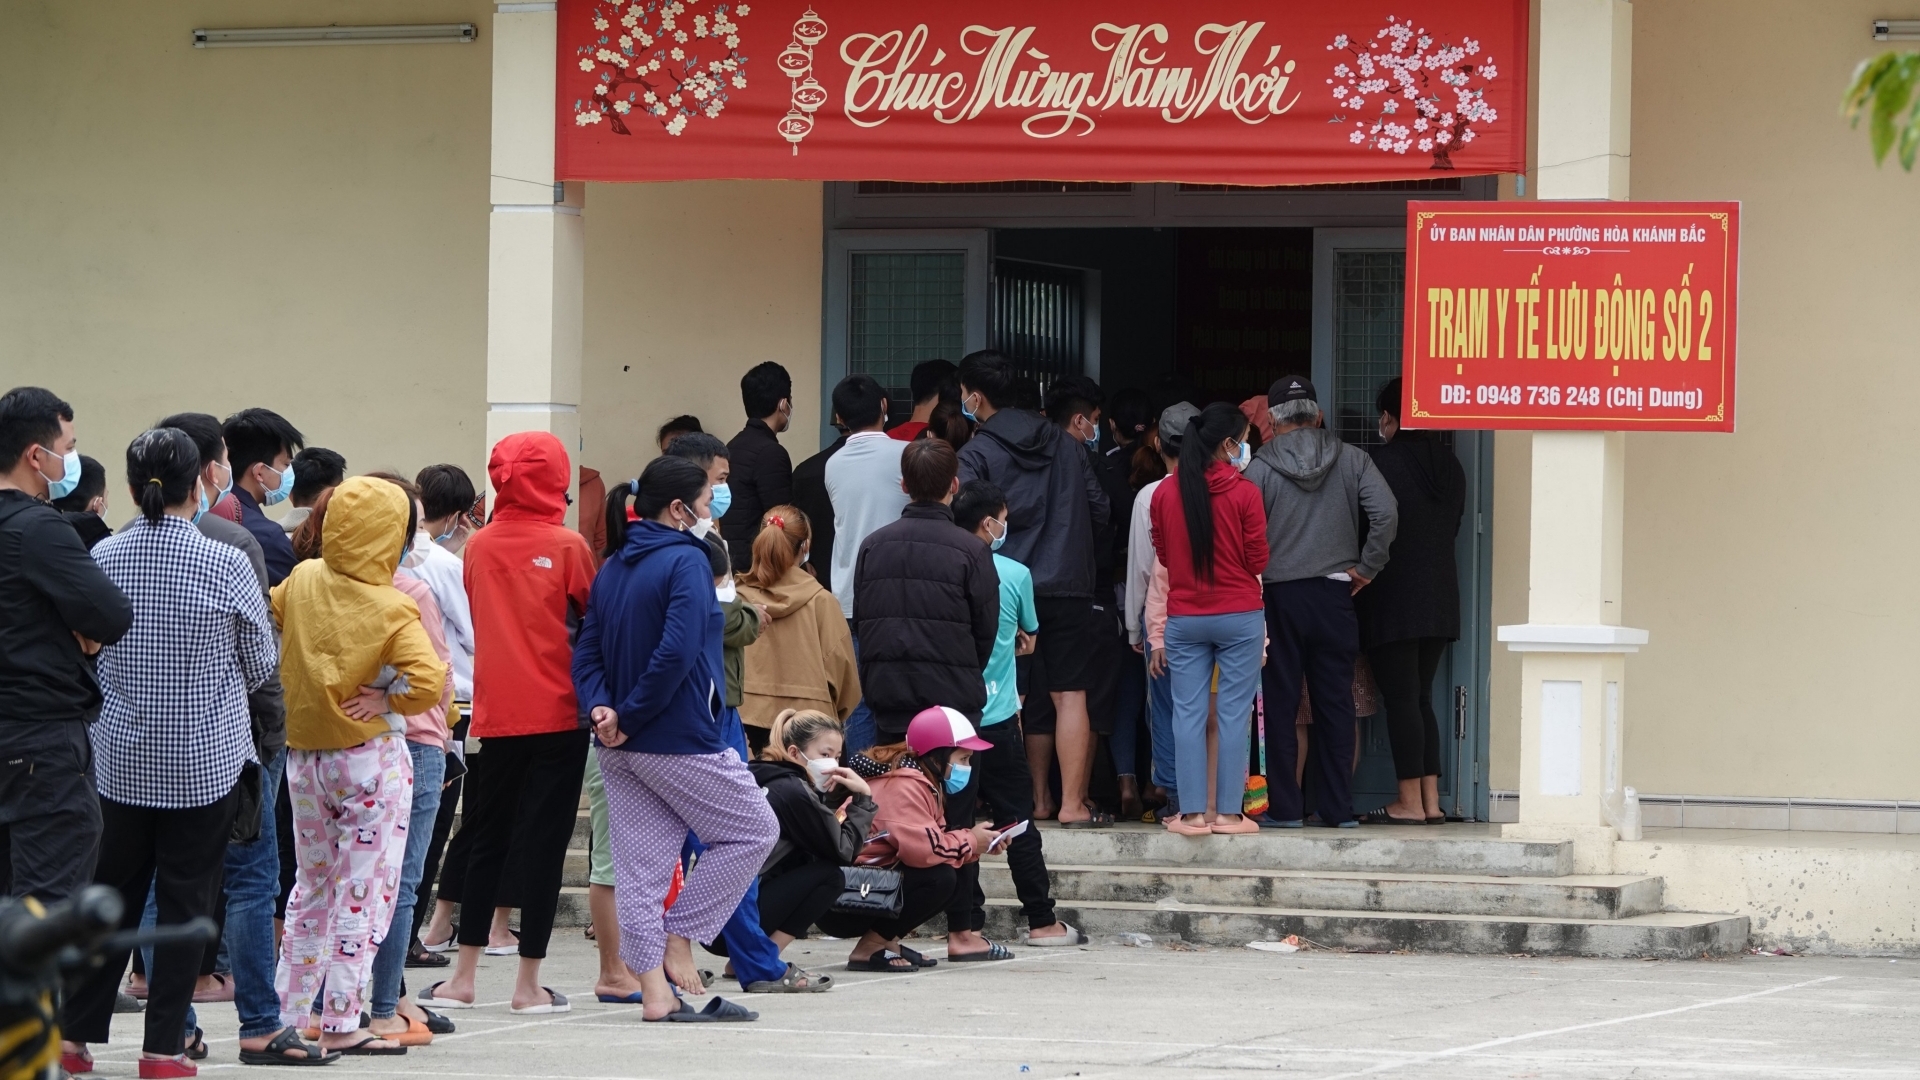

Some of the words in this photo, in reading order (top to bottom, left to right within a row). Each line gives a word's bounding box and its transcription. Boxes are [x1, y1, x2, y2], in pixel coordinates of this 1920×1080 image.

[840, 24, 966, 127] Chúc
[934, 24, 1095, 138] Mừng
[1088, 23, 1196, 112] Năm
[1162, 21, 1301, 124] Mới
[1430, 223, 1446, 241] ỦY
[1450, 228, 1476, 241] BAN
[1480, 225, 1515, 241] NHÂN
[1518, 225, 1544, 241] DÂN
[1548, 225, 1600, 242] PHƯỜNG
[1603, 225, 1629, 242] HÒA
[1632, 226, 1676, 242] KHÁNH
[1680, 223, 1706, 242] BẮC
[1428, 288, 1489, 375] TRẠM
[1496, 288, 1509, 358] Y
[1515, 264, 1543, 359] TẾ
[1547, 281, 1588, 360] LƯU
[1594, 273, 1656, 376] ĐỘNG
[1662, 262, 1694, 361] SỐ
[1698, 289, 1713, 361] 2
[1441, 384, 1471, 404] DĐ:
[1476, 385, 1521, 405] 0948
[1526, 386, 1561, 405] 736
[1565, 386, 1600, 406] 248
[1606, 387, 1643, 411] (Chị
[1649, 387, 1703, 409] Dung)
